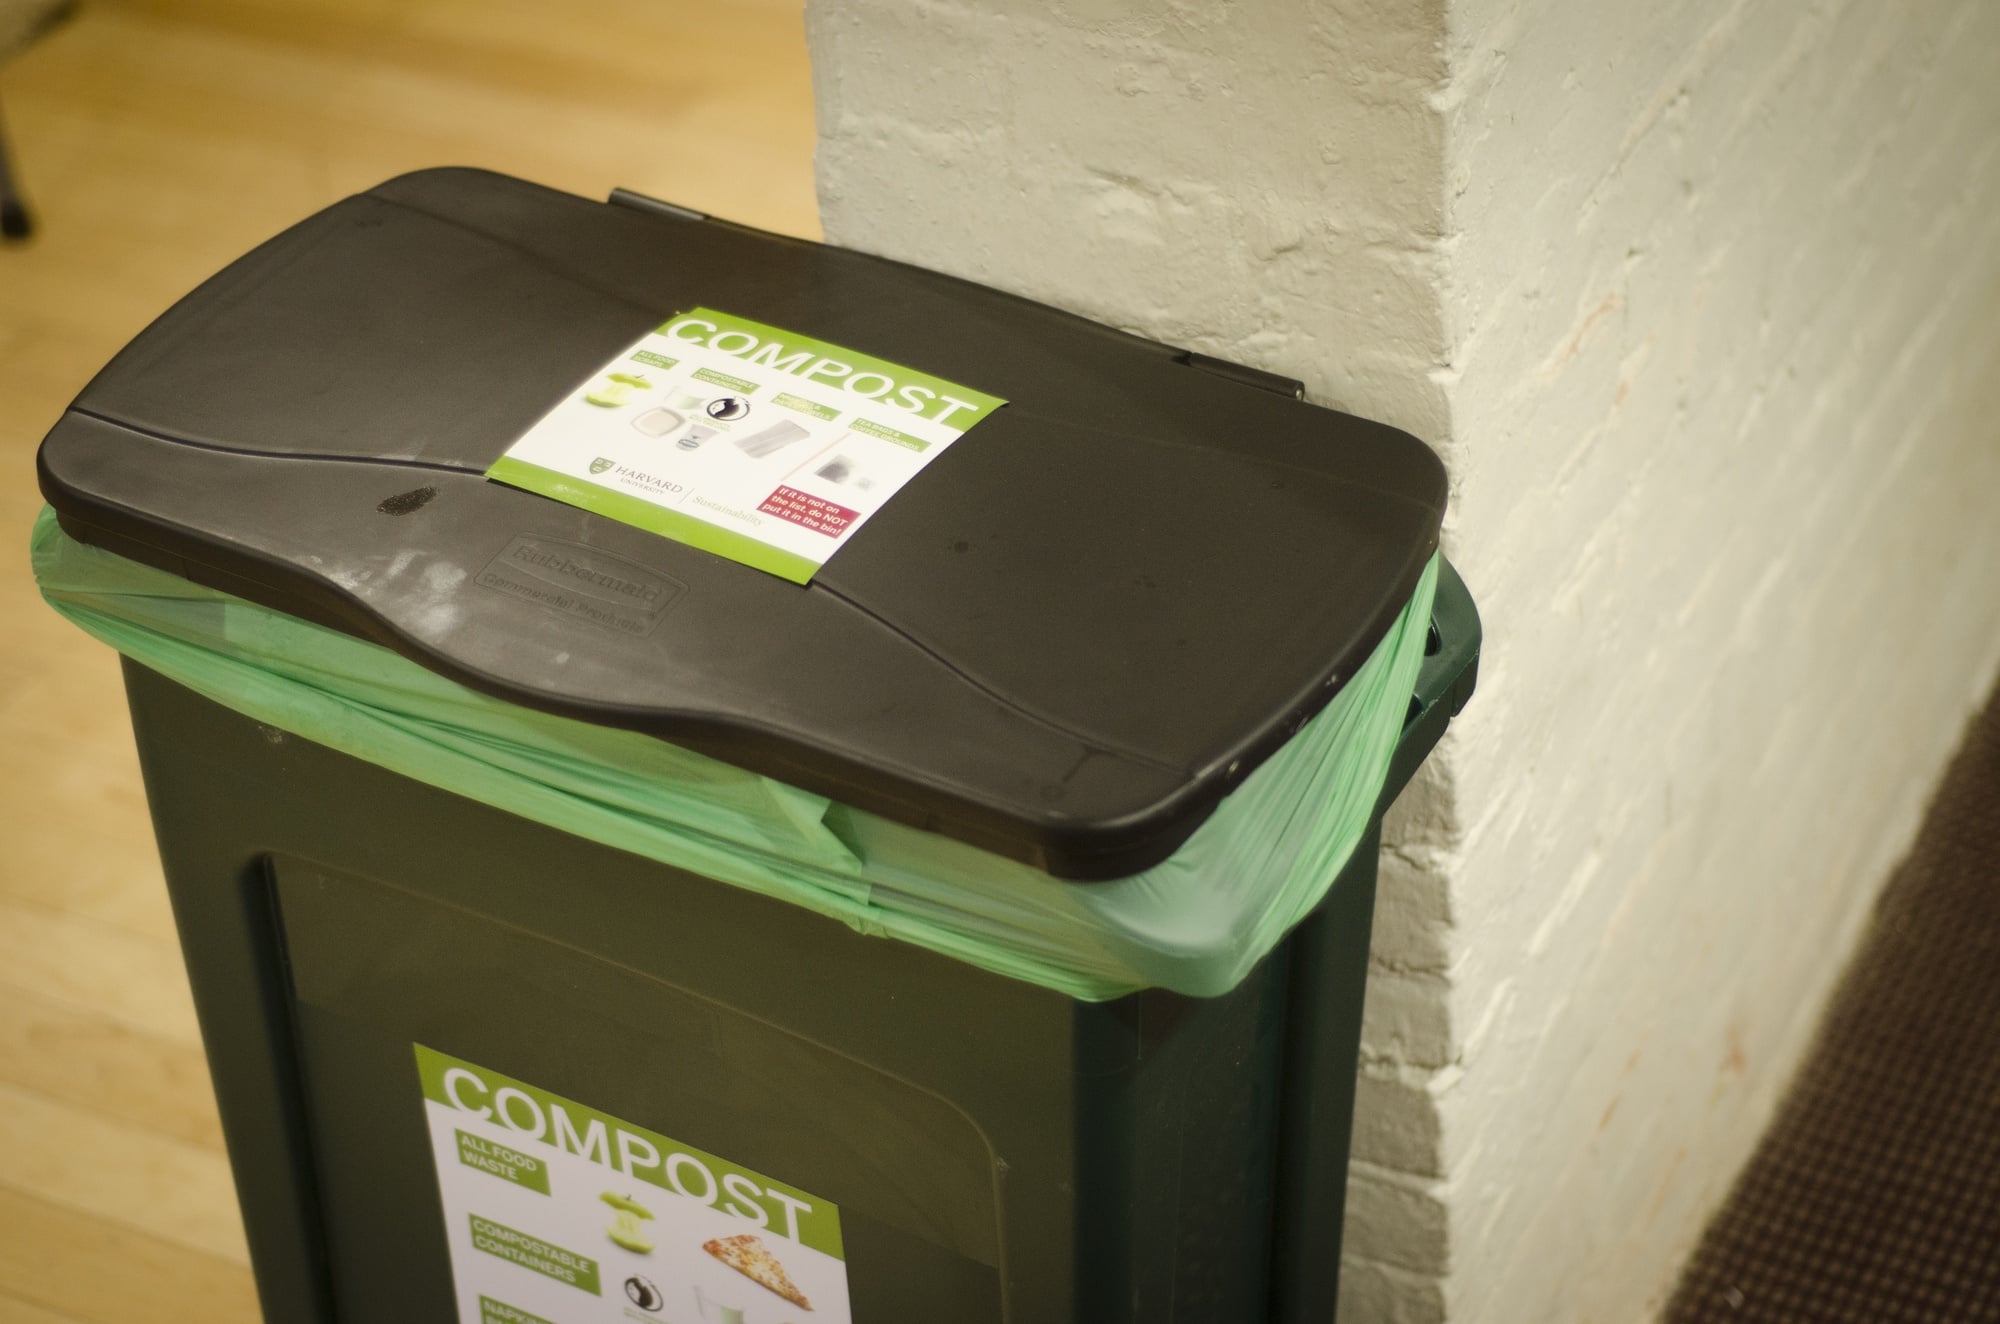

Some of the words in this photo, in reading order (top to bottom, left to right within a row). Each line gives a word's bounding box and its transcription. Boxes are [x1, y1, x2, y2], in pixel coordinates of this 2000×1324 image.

[666, 319, 979, 425] COMPOST
[615, 465, 683, 495] HARVARD
[620, 477, 665, 495] UNIVERSITY
[692, 496, 763, 526] Sustainability
[771, 495, 788, 505] the
[808, 508, 822, 518] do
[822, 513, 848, 526] NOT
[788, 490, 797, 499] it
[797, 494, 807, 502] is
[807, 498, 826, 509] not
[826, 505, 840, 514] on
[761, 503, 782, 514] put
[782, 508, 791, 517] it
[790, 512, 802, 521] in
[802, 516, 820, 527] the
[820, 523, 842, 536] bin!
[512, 545, 663, 603] Rubbermaid
[444, 1067, 812, 1246] COMPOST
[461, 1135, 486, 1155] ALL
[492, 1146, 537, 1172] FOOD
[462, 1150, 518, 1180] WASTE
[473, 1219, 590, 1273] COMPOSTABLE
[475, 1235, 576, 1283] CONTAINERS
